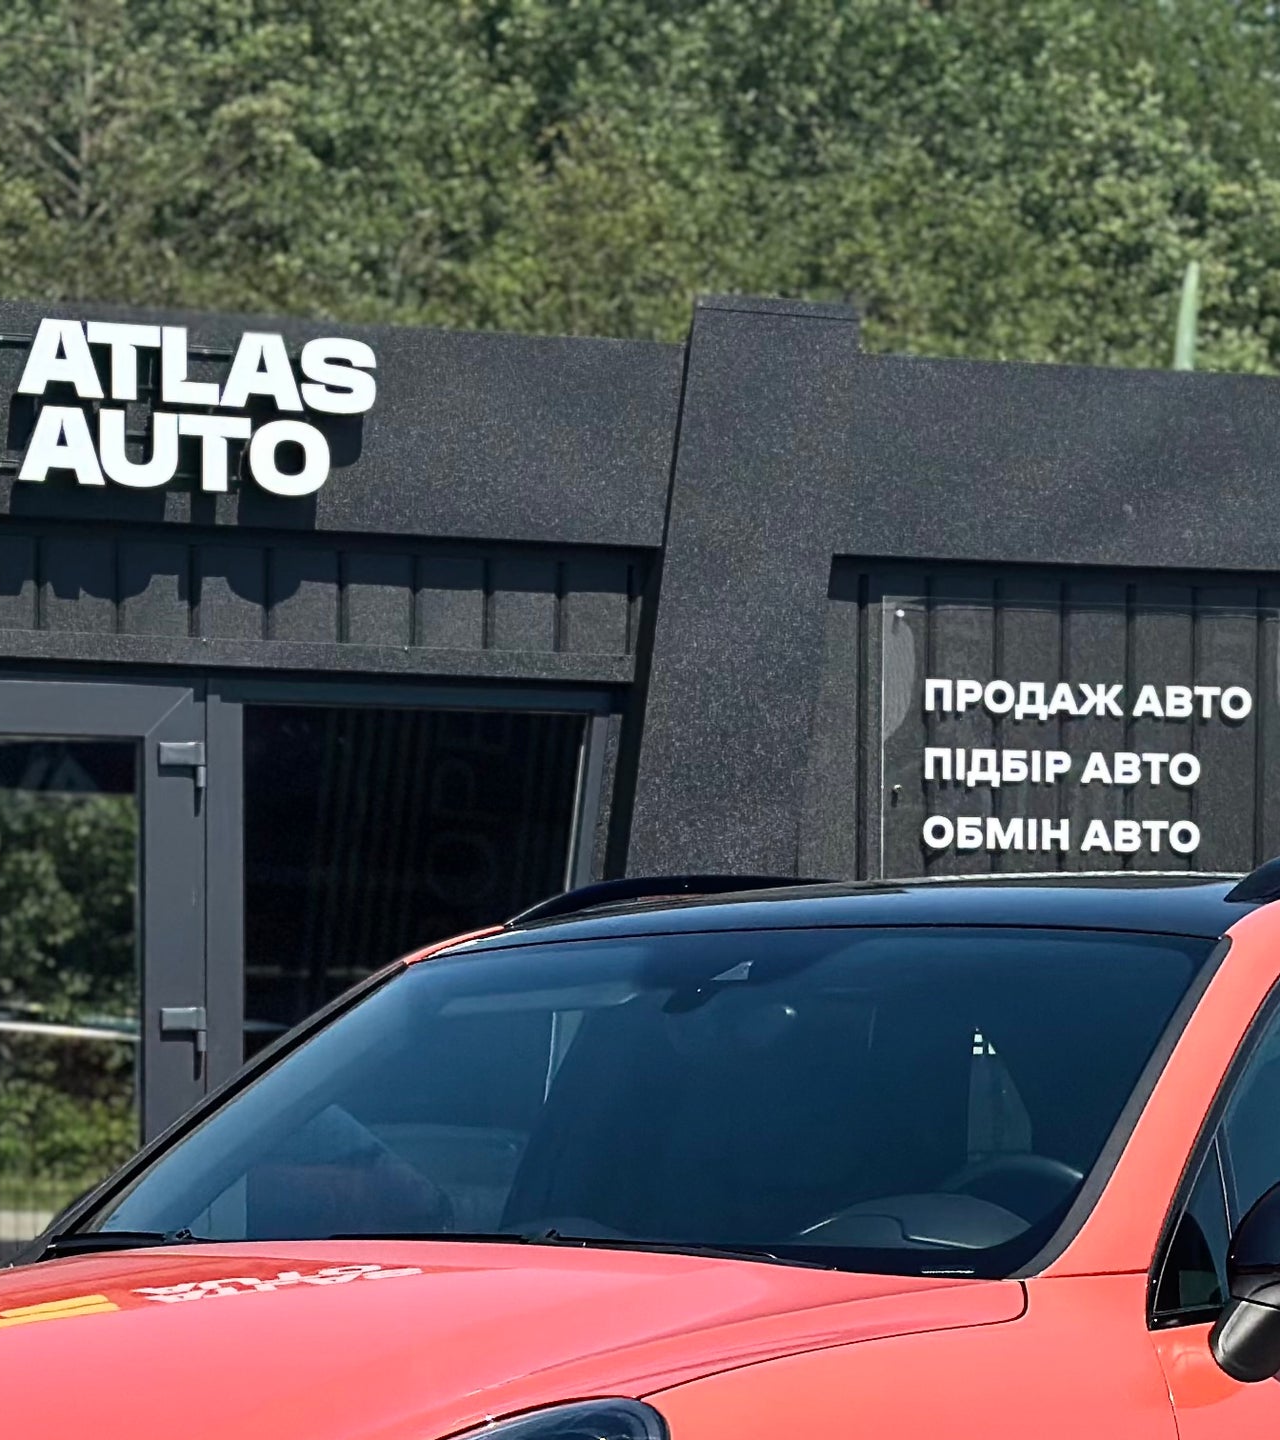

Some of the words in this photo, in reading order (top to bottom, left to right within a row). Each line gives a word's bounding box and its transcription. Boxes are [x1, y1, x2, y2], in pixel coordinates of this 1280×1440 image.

[18, 318, 377, 414] ATLAS
[18, 405, 331, 496] AUTO
[924, 679, 1123, 720] ПРОДАЖ
[1132, 685, 1252, 719] АВТО
[924, 747, 1071, 788] ПІДБІР
[1080, 752, 1201, 785] АВТО
[922, 815, 1070, 851] ОБМІН
[1080, 819, 1201, 853] АВТО
